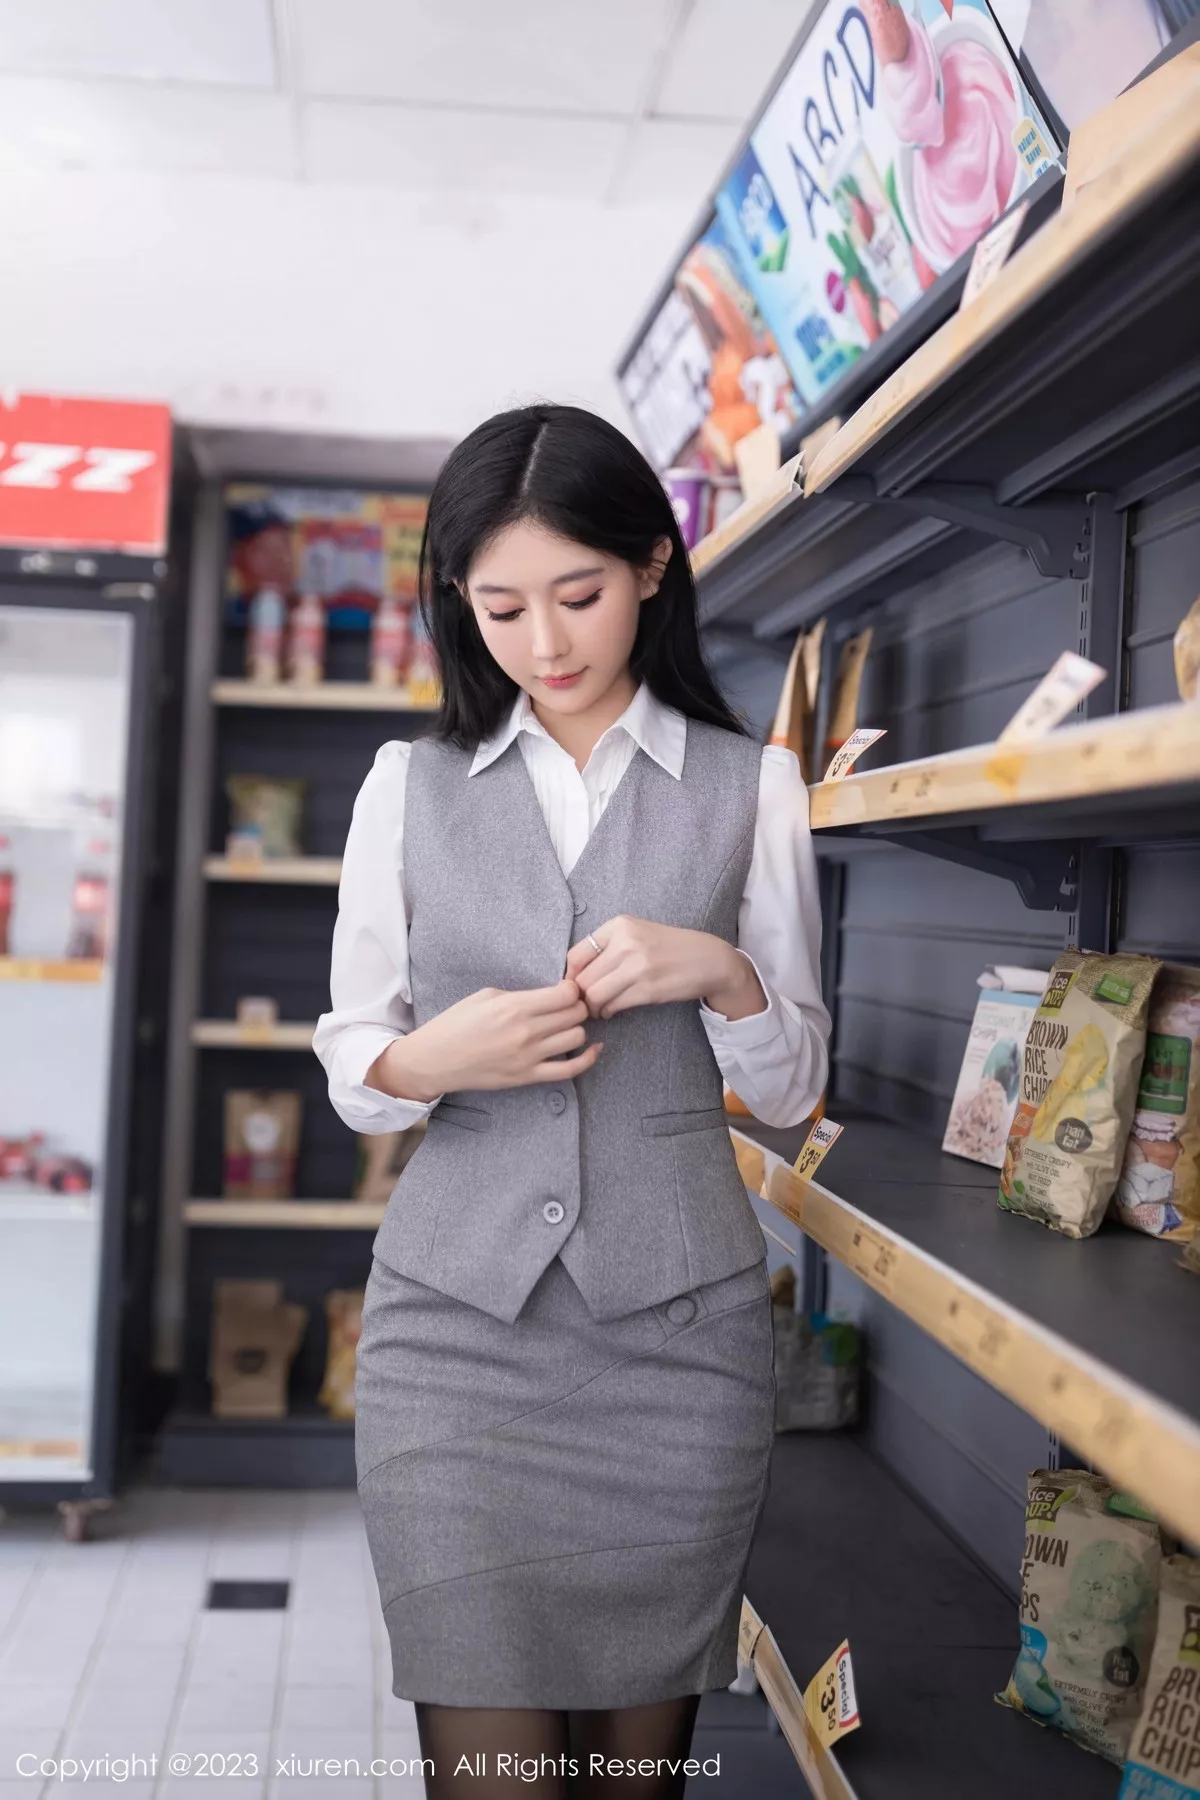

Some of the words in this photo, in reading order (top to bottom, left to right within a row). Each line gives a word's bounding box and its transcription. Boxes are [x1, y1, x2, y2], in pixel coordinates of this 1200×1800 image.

[1026, 1020, 1069, 1050] BROWN
[1024, 1046, 1048, 1076] RICE
[838, 1660, 851, 1718] Special
[1054, 1679, 1099, 1697] EXTREMELY
[1078, 1699, 1102, 1713] OLIVE
